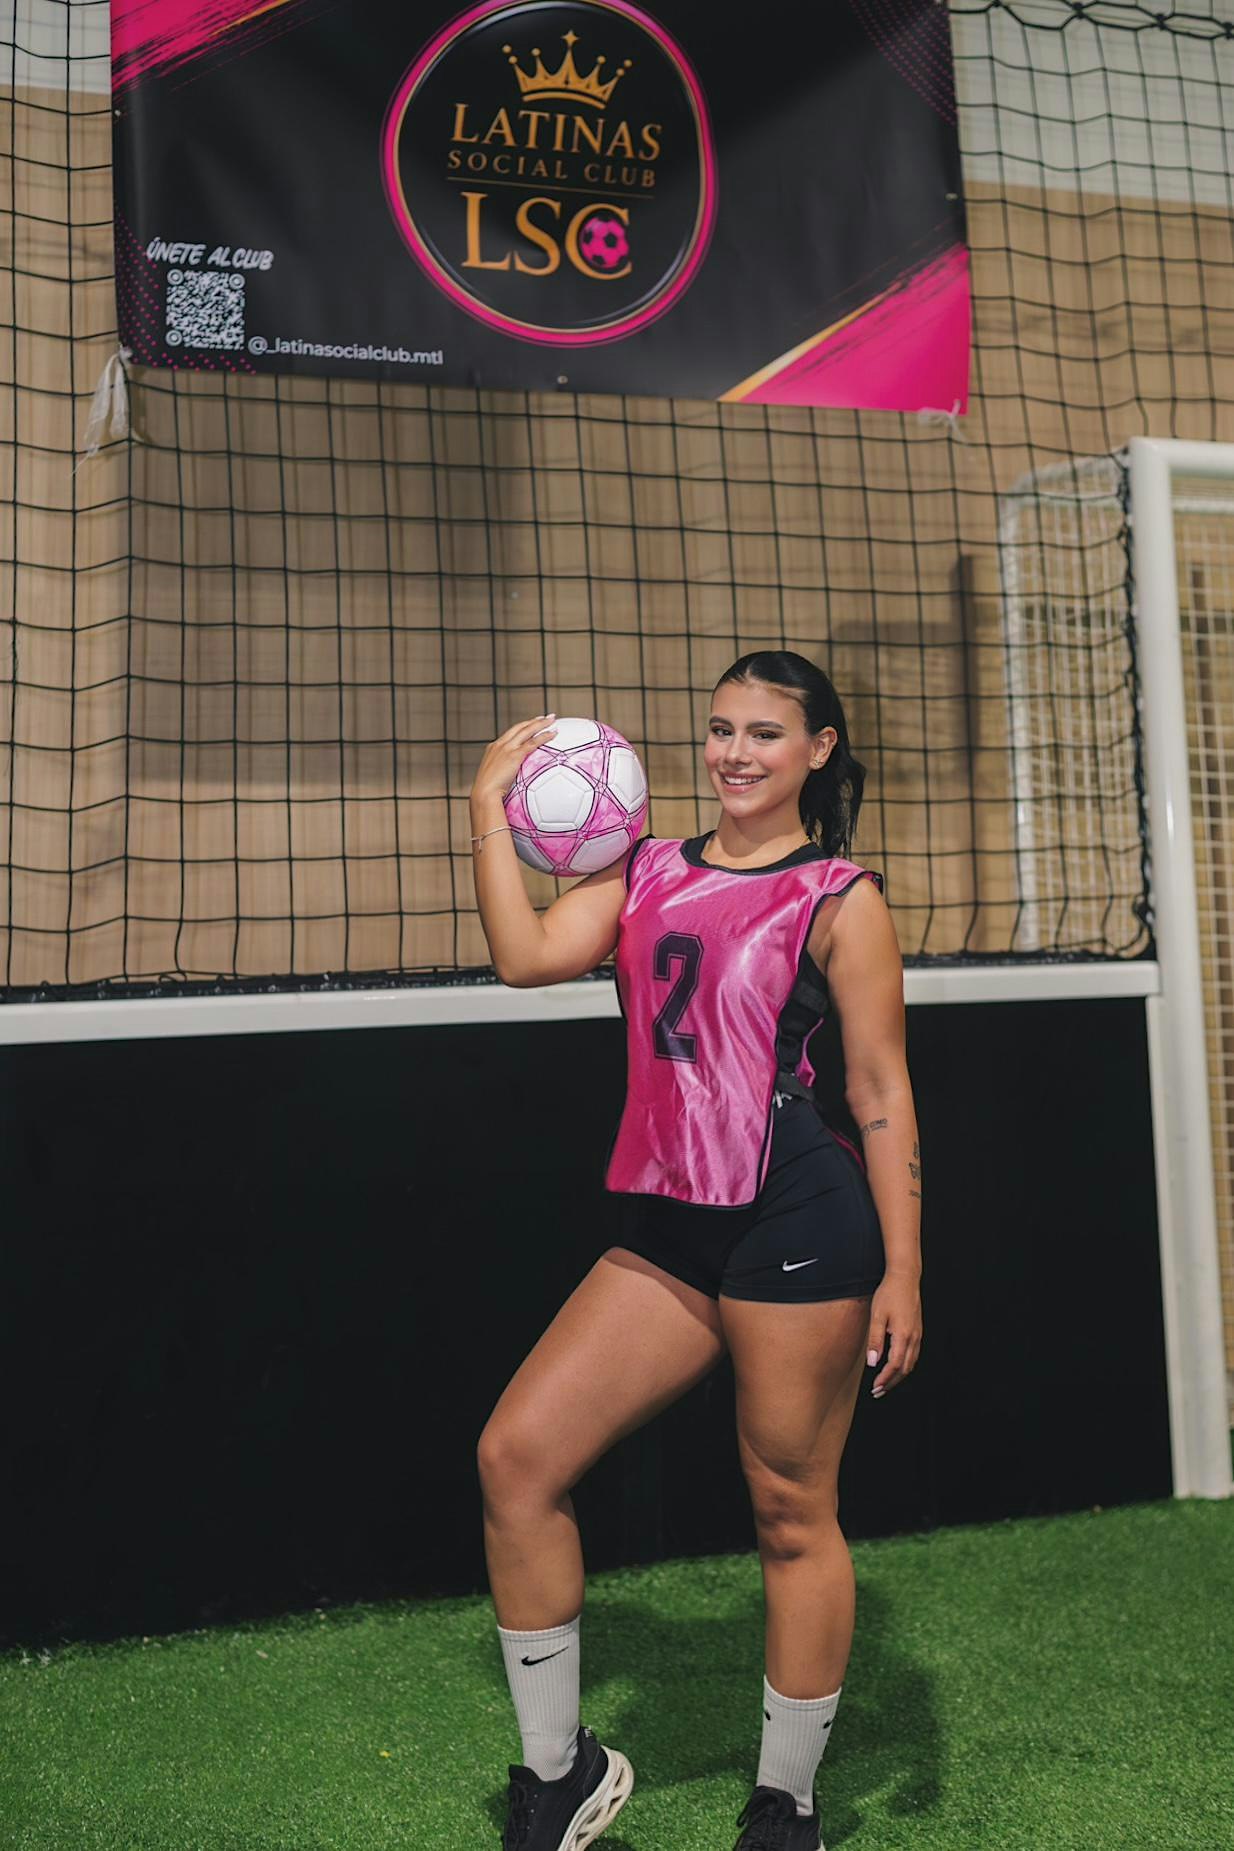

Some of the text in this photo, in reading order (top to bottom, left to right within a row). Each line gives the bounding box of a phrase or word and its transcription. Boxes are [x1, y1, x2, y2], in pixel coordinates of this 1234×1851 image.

[451, 103, 662, 160] LATINAS
[448, 150, 655, 187] SOCIAL CLUB
[146, 237, 274, 270] ÚNETE AL CLUB
[461, 191, 632, 279] LSC
[248, 335, 443, 365] @_latinasocialclub.mtl
[652, 931, 704, 1064] 2
